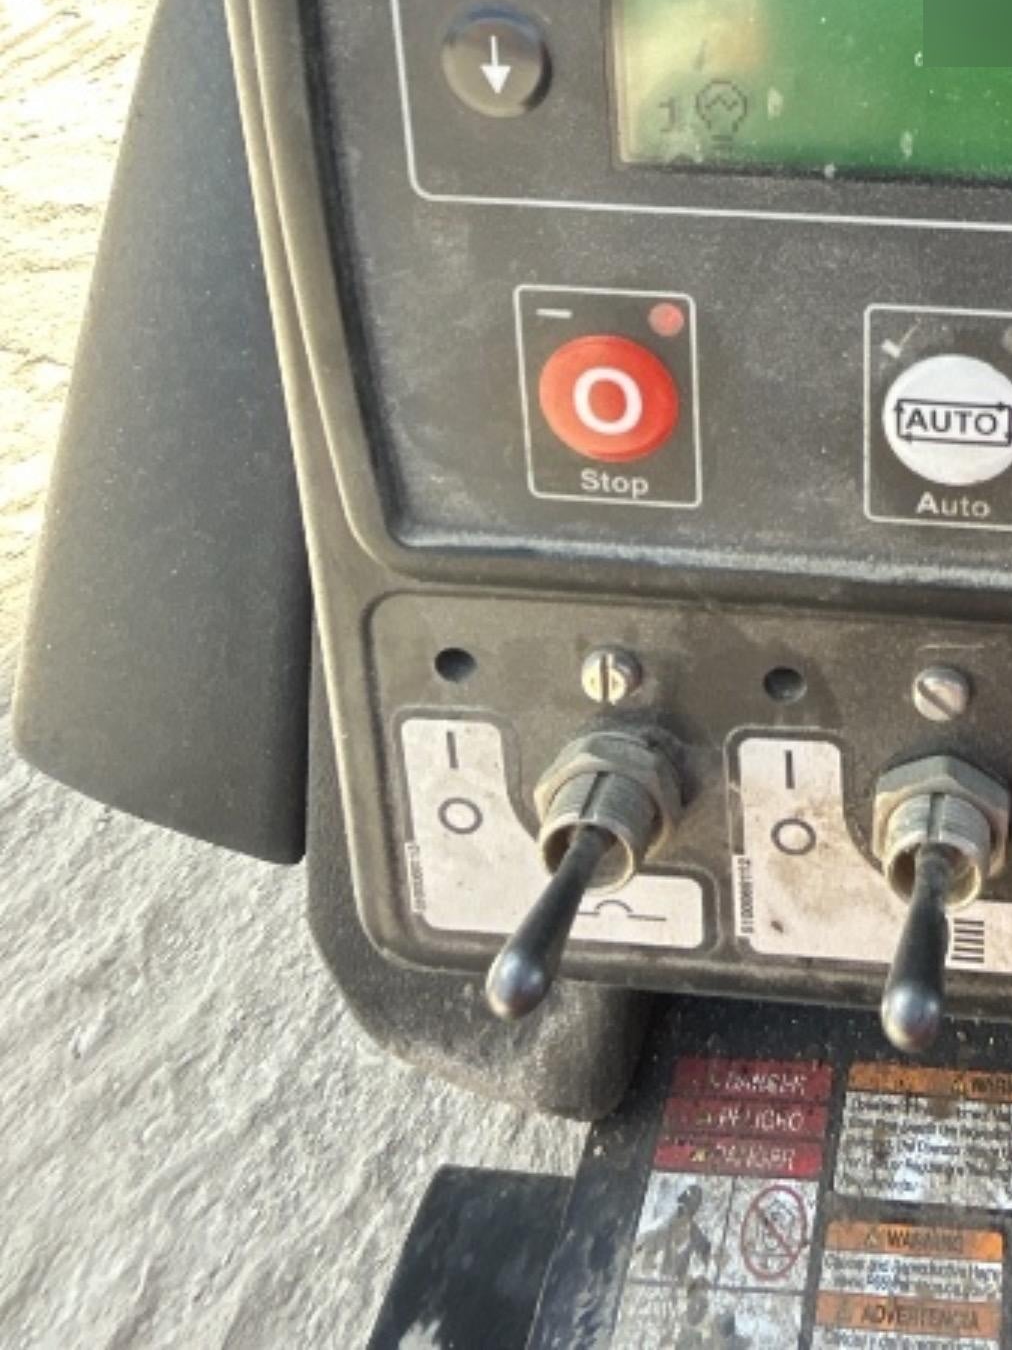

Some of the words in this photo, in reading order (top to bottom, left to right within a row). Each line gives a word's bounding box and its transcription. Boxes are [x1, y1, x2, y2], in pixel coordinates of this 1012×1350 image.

[905, 407, 998, 436] AUTO
[580, 468, 650, 500] Stop
[916, 491, 992, 518] Auto
